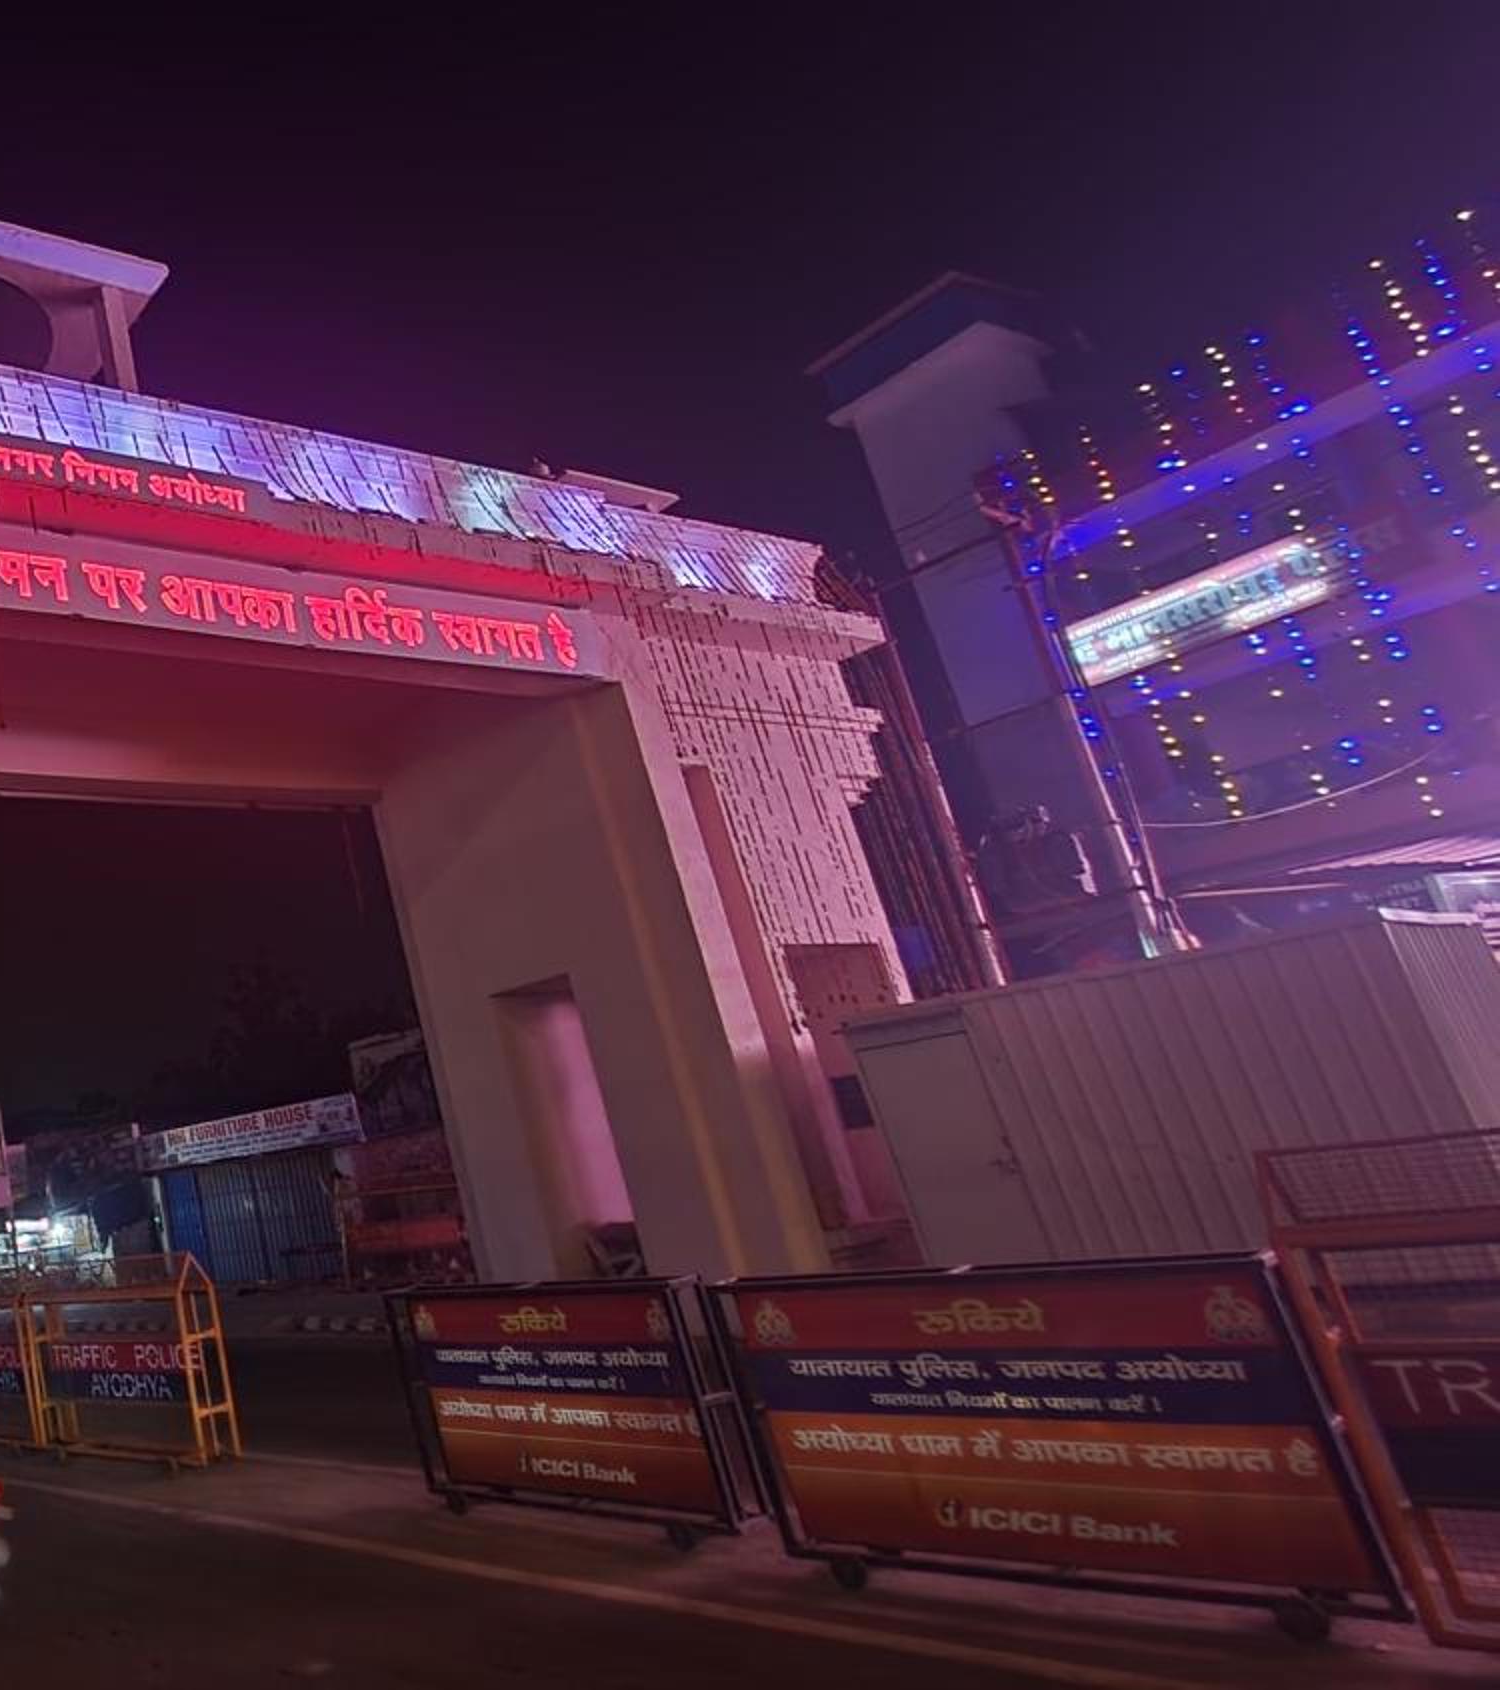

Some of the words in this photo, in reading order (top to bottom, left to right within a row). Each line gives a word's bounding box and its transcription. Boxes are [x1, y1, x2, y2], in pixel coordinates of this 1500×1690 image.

[60, 450, 139, 495] निगम
[149, 472, 246, 514] अयोध्या
[81, 560, 146, 612] पर
[160, 573, 296, 633] आपका
[304, 586, 424, 649] हार्दिक
[431, 609, 544, 661] स्वागत
[548, 612, 578, 670] है
[189, 1114, 260, 1142] FURNITURE
[263, 1104, 315, 1129] HOUSE
[52, 1344, 117, 1367] TRAFFIC
[134, 1344, 200, 1369] POLICE
[789, 1358, 890, 1377] यातायात
[1116, 1352, 1247, 1382] अयोध्या
[91, 1373, 173, 1398] AYODHYA
[793, 1424, 895, 1454] अयोध्या
[900, 1432, 964, 1458] धाम
[970, 1429, 1003, 1459] में
[1013, 1440, 1129, 1467] आपका
[1138, 1442, 1274, 1473] स्वागत
[1285, 1439, 1318, 1476] है
[531, 1458, 579, 1476] ICICI
[583, 1464, 636, 1484] Bank
[970, 1507, 1060, 1536] ICICI
[1071, 1515, 1179, 1546] Bank
